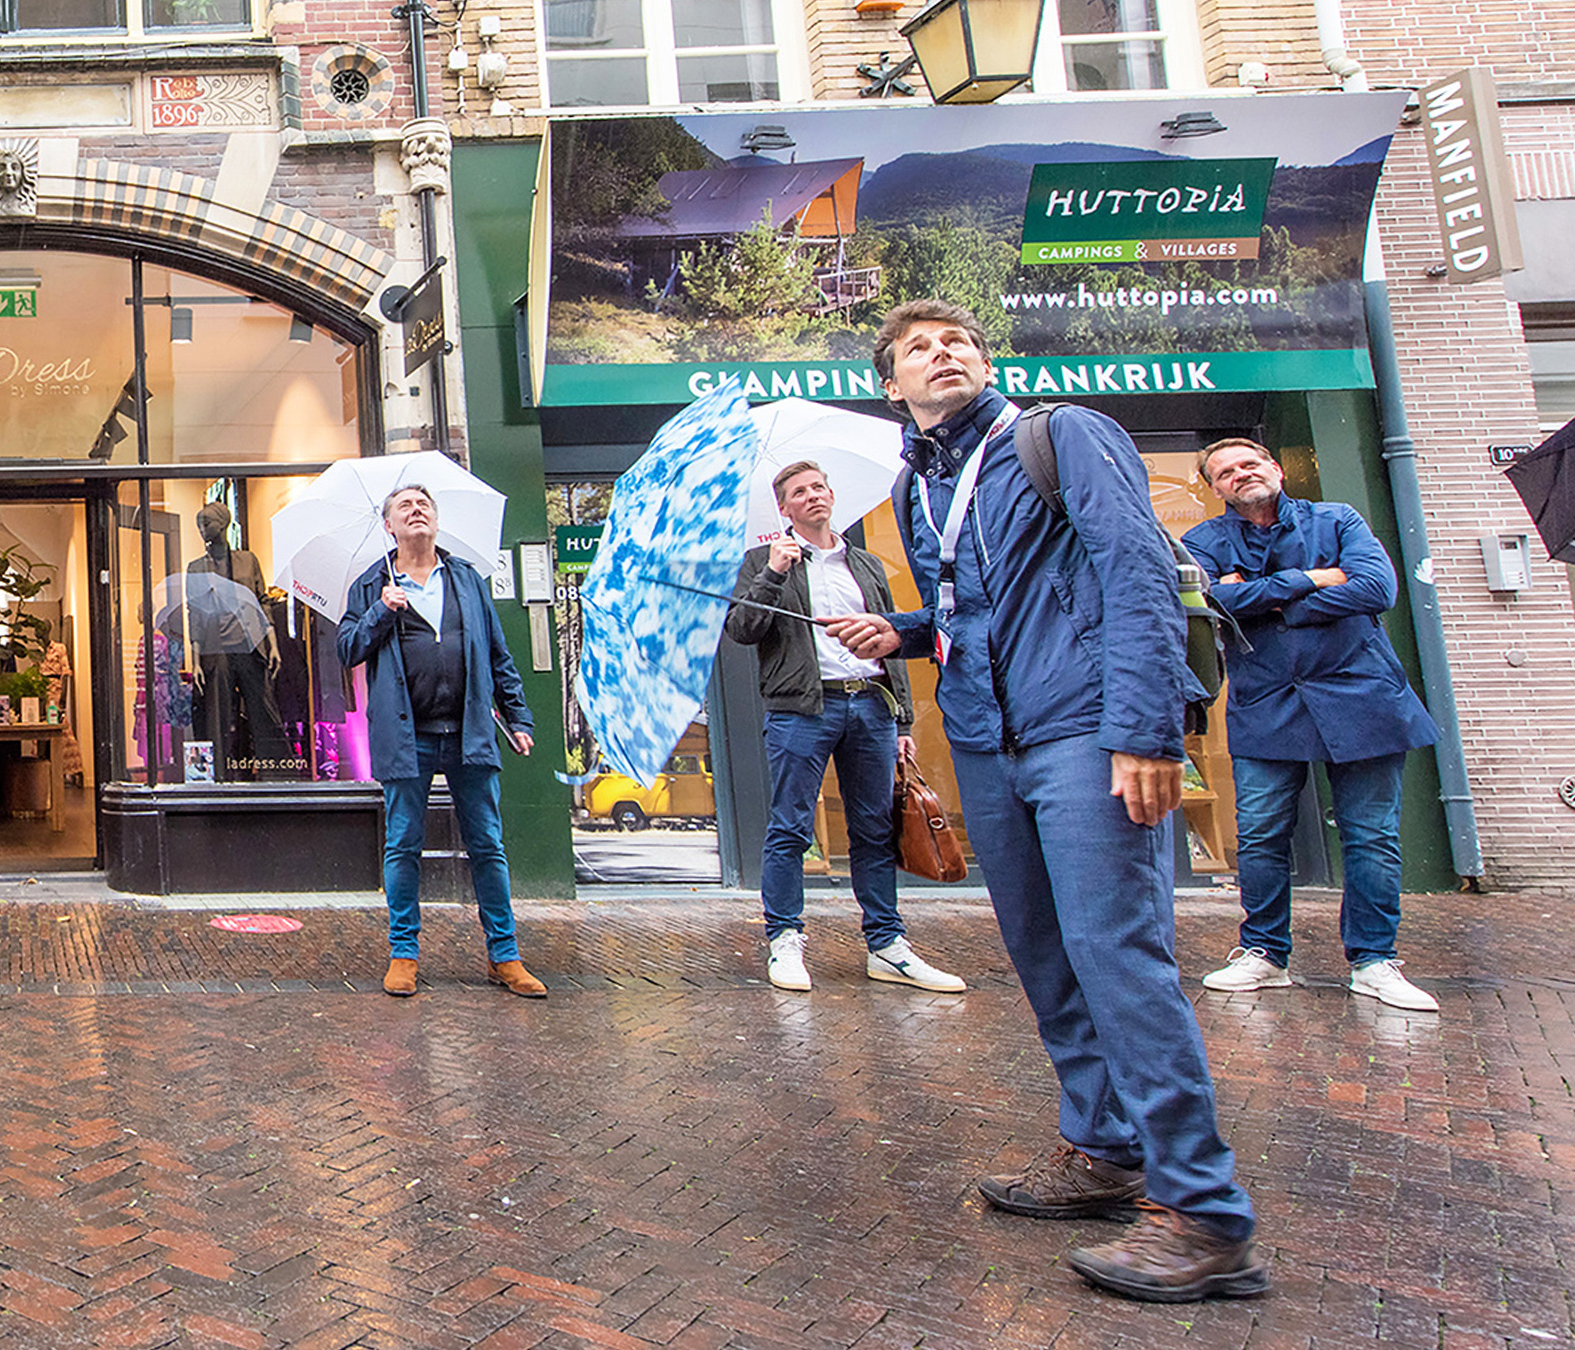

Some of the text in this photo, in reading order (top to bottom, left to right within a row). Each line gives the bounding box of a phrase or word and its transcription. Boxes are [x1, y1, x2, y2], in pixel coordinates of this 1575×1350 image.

[153, 104, 198, 127] 1896
[1425, 81, 1489, 273] MANFIELD
[1038, 241, 1237, 260] CAMPINGS & VILLAGES
[999, 282, 1278, 315] www.huttopia.com
[10, 383, 90, 398] by Simone
[688, 368, 875, 397] GAMPIN
[226, 756, 308, 770] ladress.com
